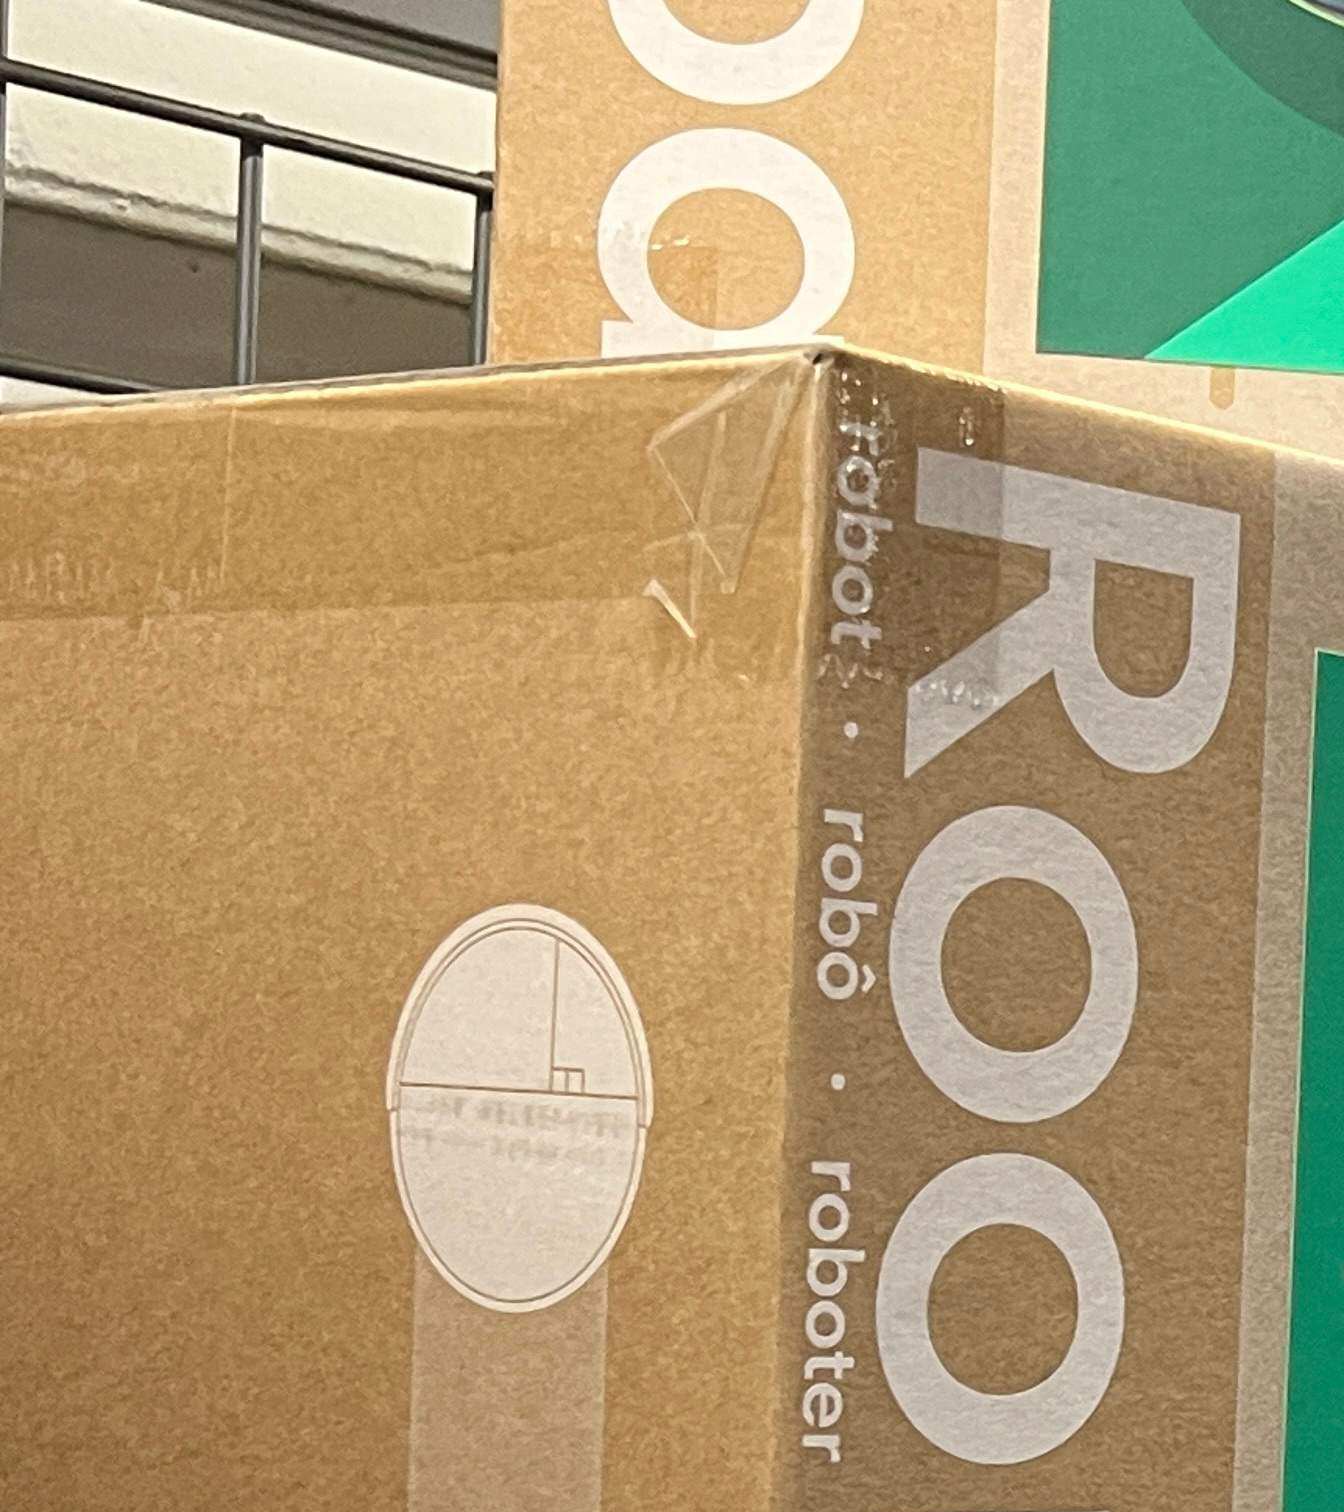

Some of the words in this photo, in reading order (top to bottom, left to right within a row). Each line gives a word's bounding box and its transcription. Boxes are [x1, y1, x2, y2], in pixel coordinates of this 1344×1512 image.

[829, 418, 895, 651] robot
[816, 807, 879, 1002] robô
[802, 1158, 867, 1466] roboter
